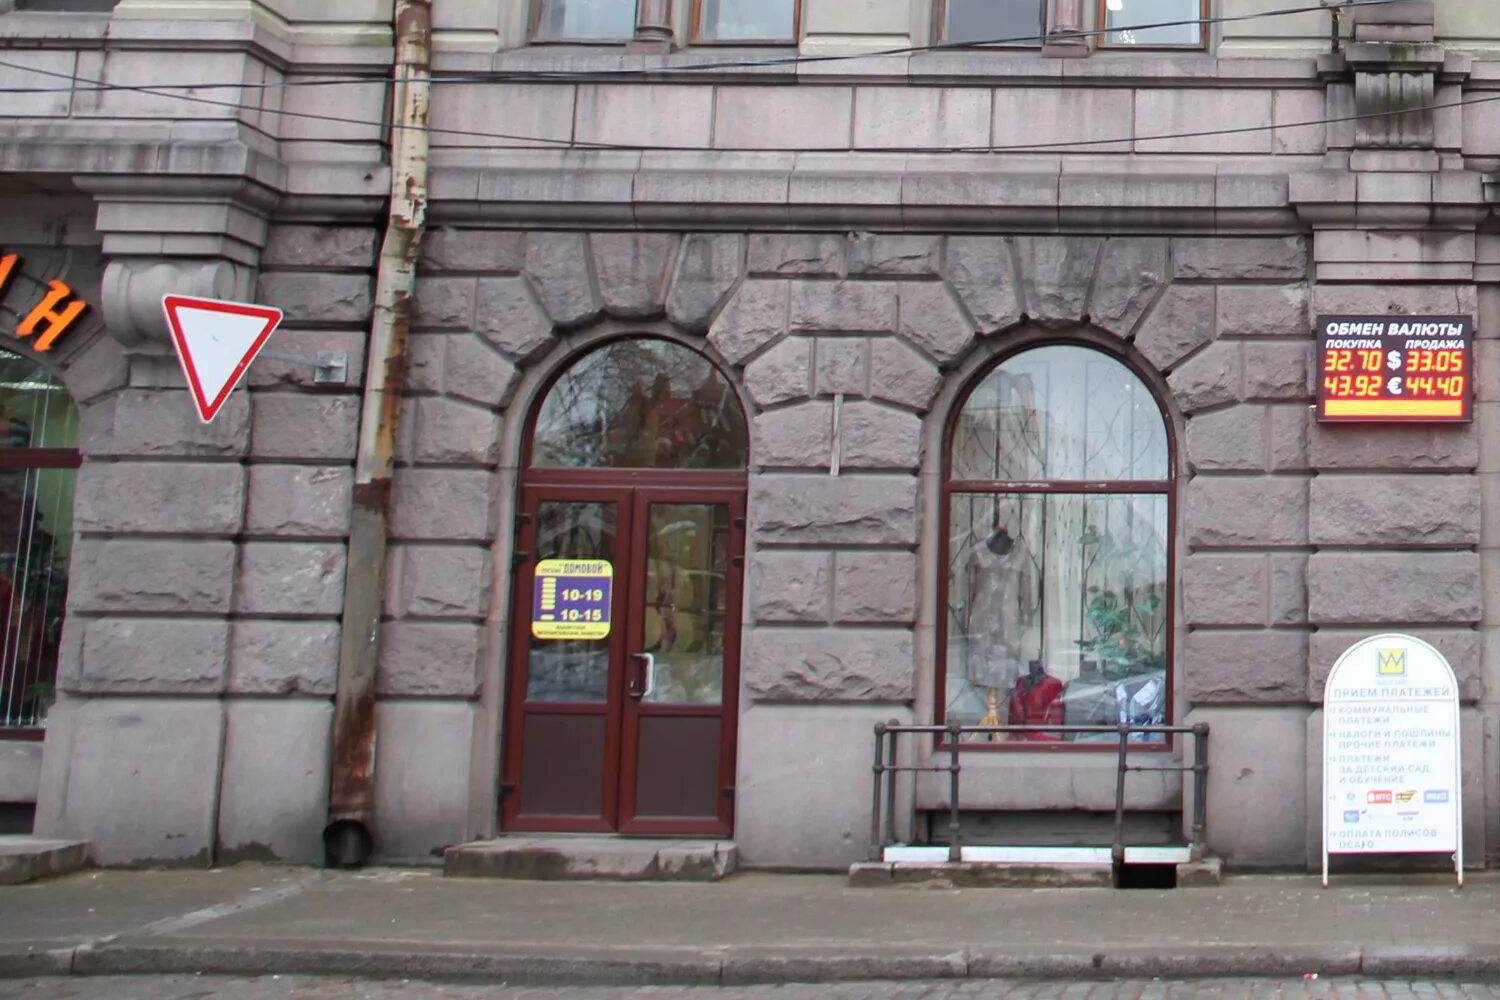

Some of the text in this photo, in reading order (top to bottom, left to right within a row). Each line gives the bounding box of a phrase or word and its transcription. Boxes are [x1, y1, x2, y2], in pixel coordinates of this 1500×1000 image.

[1326, 323, 1463, 336] ОБМЕН ВАЛЮТЫ
[1325, 339, 1465, 350] ПОКУПКА ПРОДАЖА
[1324, 350, 1463, 372] 32.70 $ 33.05
[1324, 376, 1464, 396] 43.92 € 44.40
[561, 588, 603, 601] 10-19
[560, 608, 602, 621] 10-15
[1334, 686, 1450, 698] ПРИЕМ ПЛАТЕЖЕЙ
[1338, 706, 1429, 714] КОММУНАЛЬНЫЕ
[1338, 716, 1390, 725] ПЛАТЕЖИ
[1338, 730, 1381, 738] НАЛОГИ
[1384, 730, 1391, 738] И
[1338, 740, 1436, 749] ПРОЧИЕ ПЛАТЕЖИ
[1338, 755, 1390, 763] ПЛАТЕЖИ
[1408, 765, 1430, 774] САД
[1339, 775, 1405, 784] И ОБУЧЕНИЕ
[1339, 829, 1437, 839] ОПЛАТА ПОЛИСОВ
